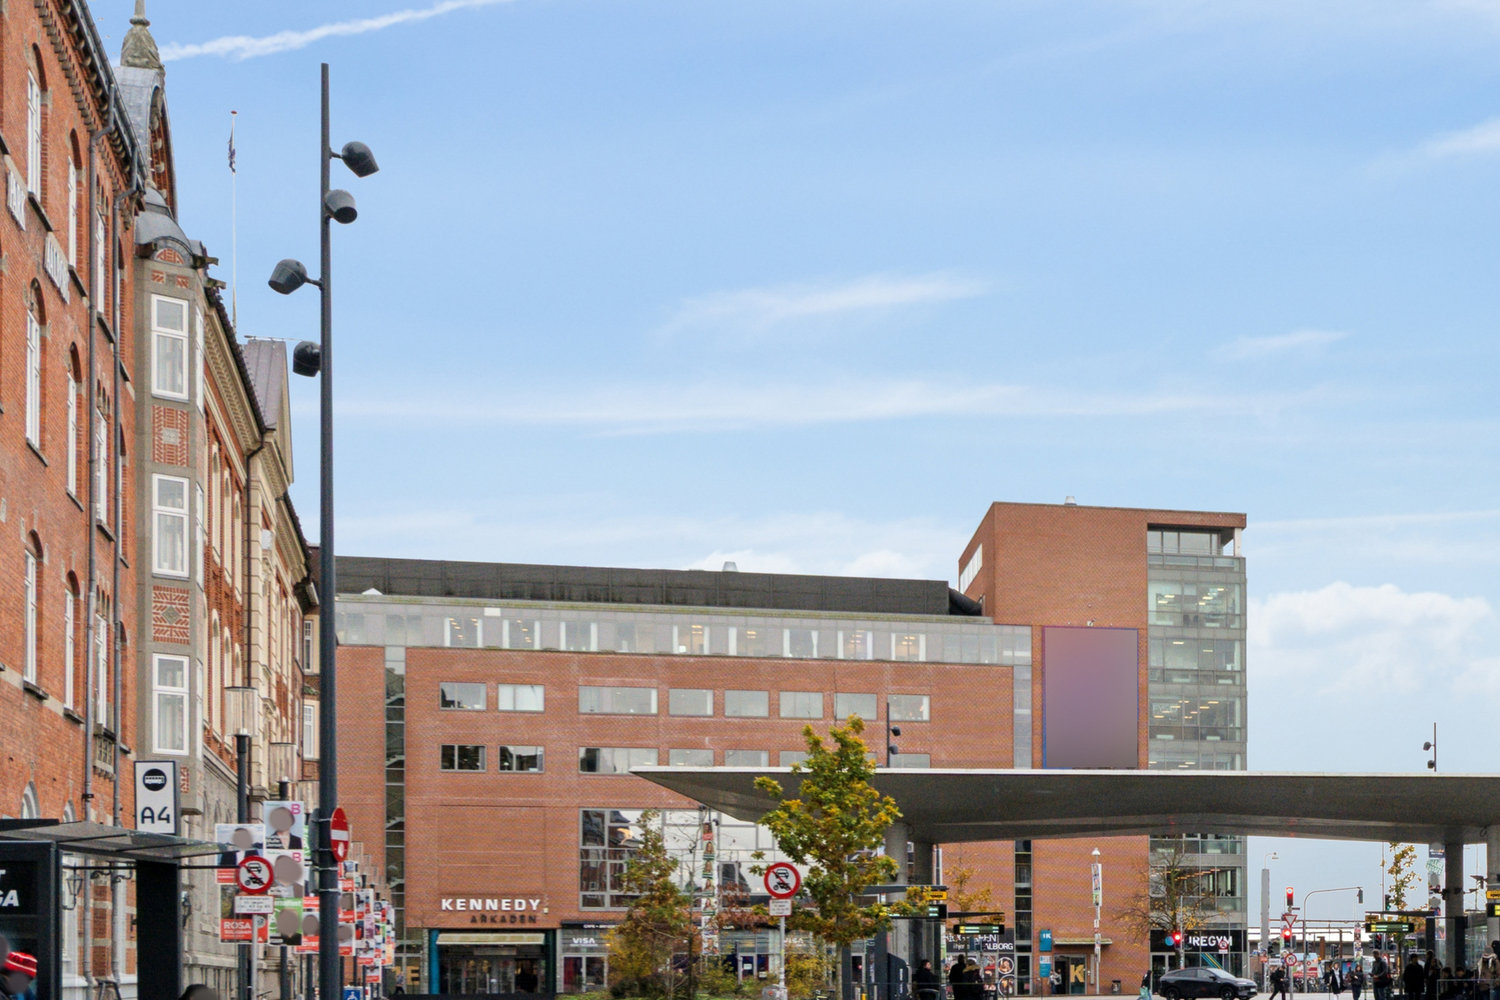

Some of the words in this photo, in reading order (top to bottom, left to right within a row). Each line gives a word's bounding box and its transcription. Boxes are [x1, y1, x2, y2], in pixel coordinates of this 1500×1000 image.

[141, 806, 171, 824] A4
[441, 899, 541, 911] KENNEDY
[223, 921, 251, 929] ROSA
[470, 915, 537, 924] ARKADEN
[1189, 935, 1233, 947] REGYM
